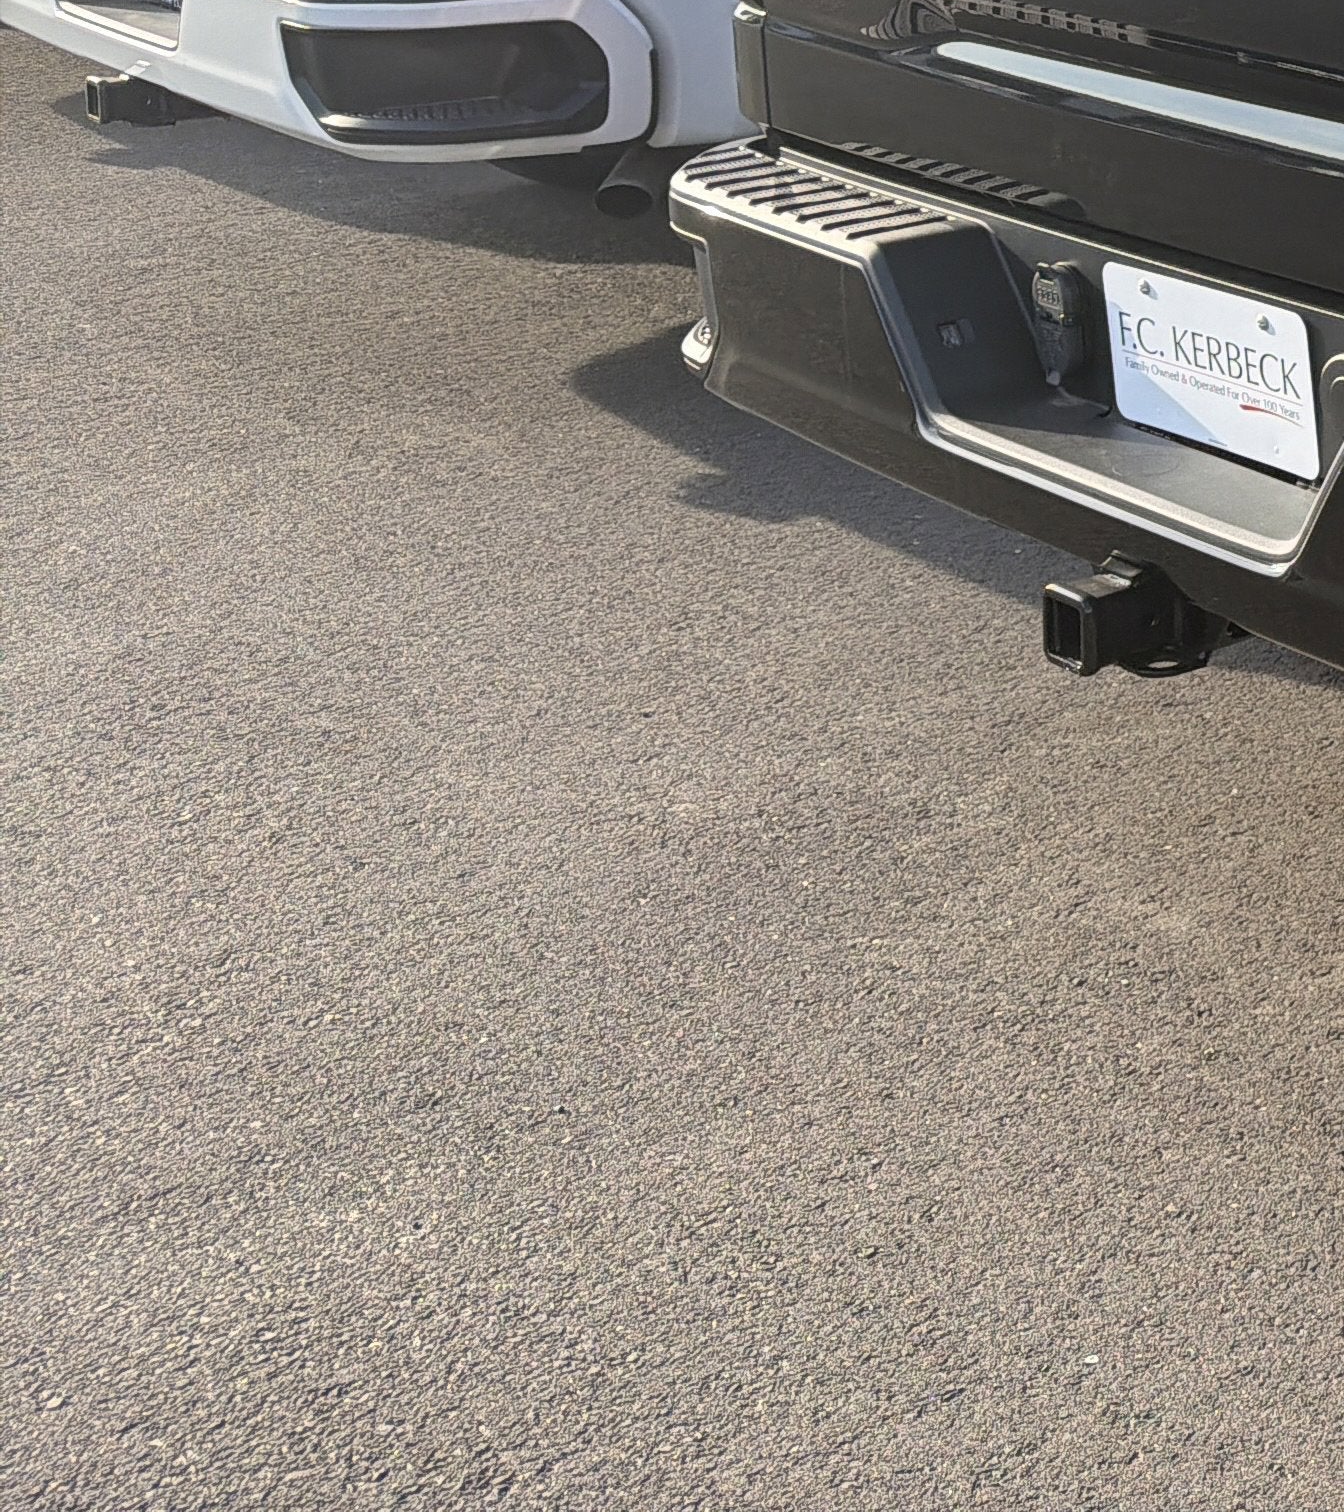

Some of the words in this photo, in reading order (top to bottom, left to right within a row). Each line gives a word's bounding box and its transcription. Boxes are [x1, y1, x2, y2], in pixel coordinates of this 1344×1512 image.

[1118, 310, 1165, 357] F.C.
[1172, 326, 1301, 399] KERBECK
[1125, 356, 1150, 377] Family
[1151, 364, 1180, 384] Owned
[1189, 376, 1226, 398] Operated
[1227, 385, 1240, 401] For
[1241, 391, 1261, 407] Over
[1278, 403, 1301, 421] Years
